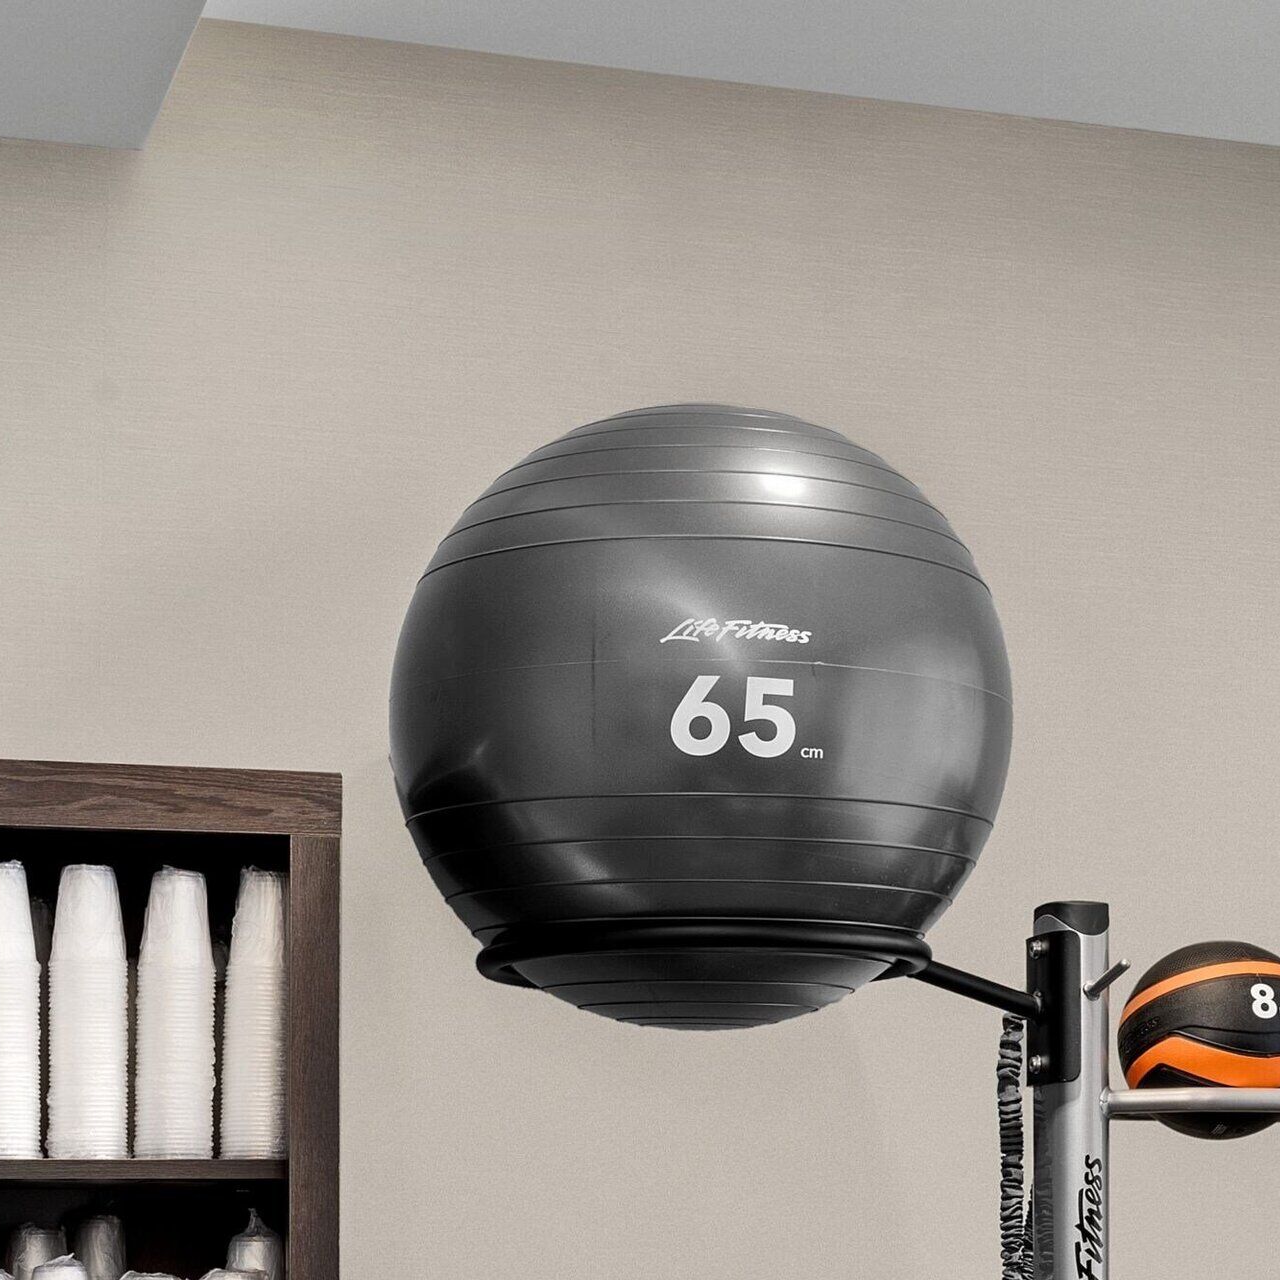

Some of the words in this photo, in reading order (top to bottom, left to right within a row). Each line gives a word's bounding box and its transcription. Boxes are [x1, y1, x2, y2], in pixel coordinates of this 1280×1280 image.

[670, 675, 797, 758] 65
[800, 747, 824, 759] cm
[1250, 984, 1278, 1019] 8
